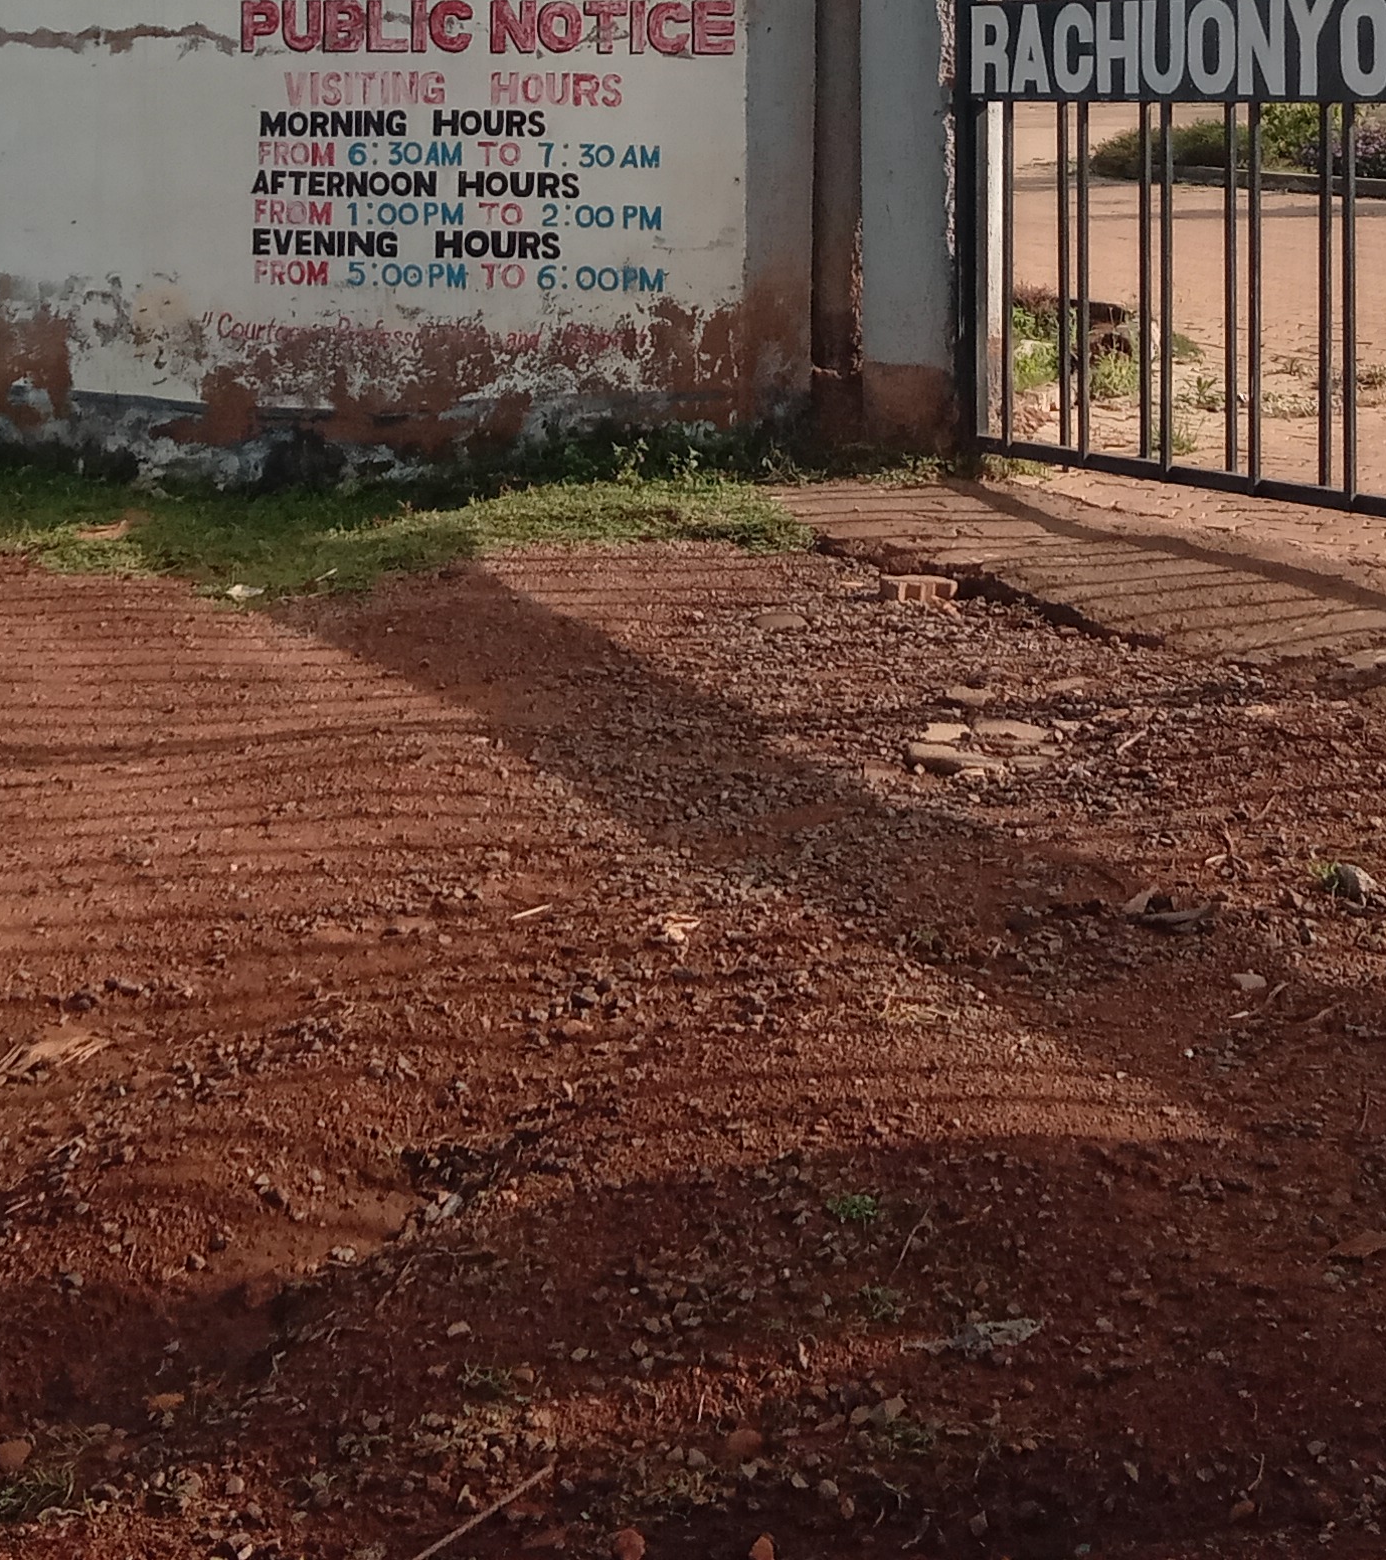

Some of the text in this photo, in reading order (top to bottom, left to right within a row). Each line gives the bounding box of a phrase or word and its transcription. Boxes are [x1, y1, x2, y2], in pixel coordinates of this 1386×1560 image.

[240, 0, 474, 54] PUBLIC
[284, 71, 623, 108] VISITING HOURS
[260, 109, 547, 137] MORNING HOURS
[258, 140, 336, 167] FROM
[477, 141, 521, 167] TO
[251, 170, 580, 199] AFTERNOON HOURS
[254, 199, 333, 226] FROM
[478, 201, 523, 226] TO
[252, 228, 561, 260] EVENING HOURS
[254, 260, 329, 286] FROM
[480, 263, 525, 289] TO
